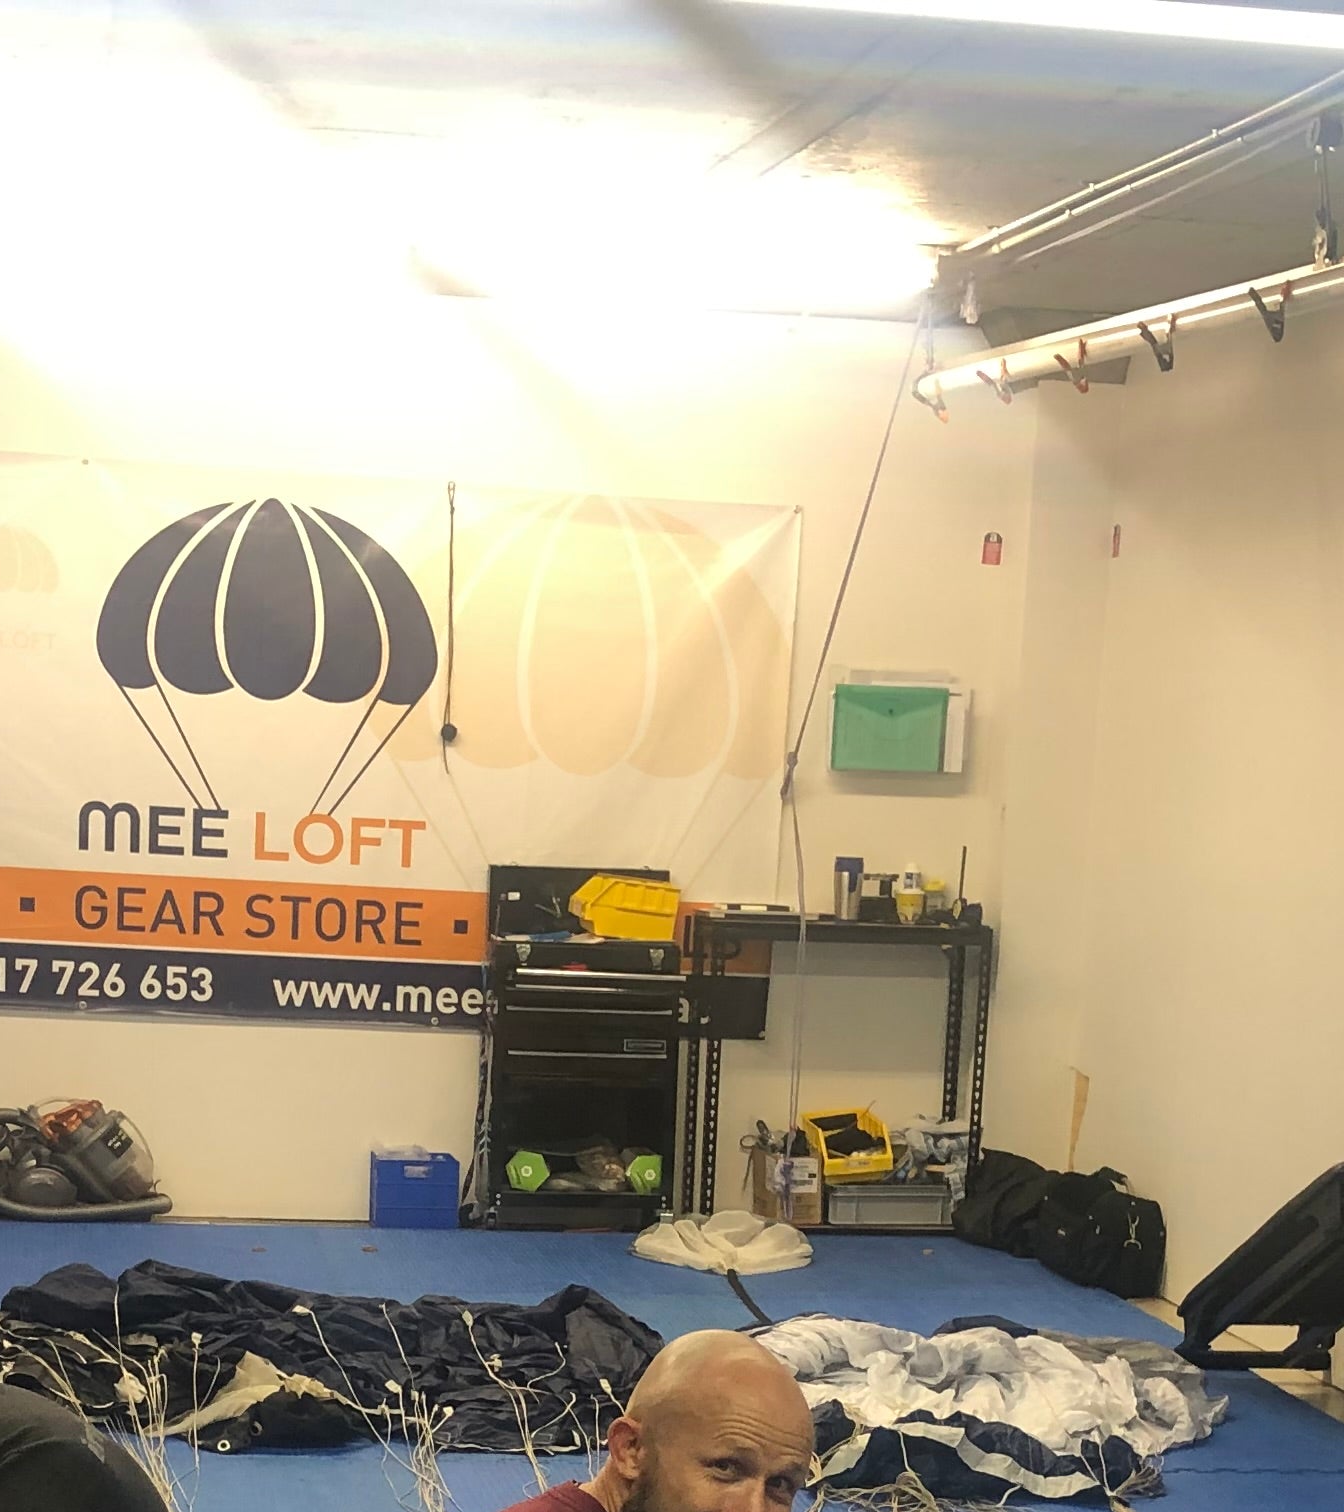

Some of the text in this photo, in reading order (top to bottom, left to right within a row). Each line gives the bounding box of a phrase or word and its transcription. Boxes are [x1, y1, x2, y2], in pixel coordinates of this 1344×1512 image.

[78, 800, 427, 868] MEE LOFT
[74, 884, 425, 947] GEAR STORE
[51, 960, 126, 999] 726
[139, 965, 214, 1003] 653
